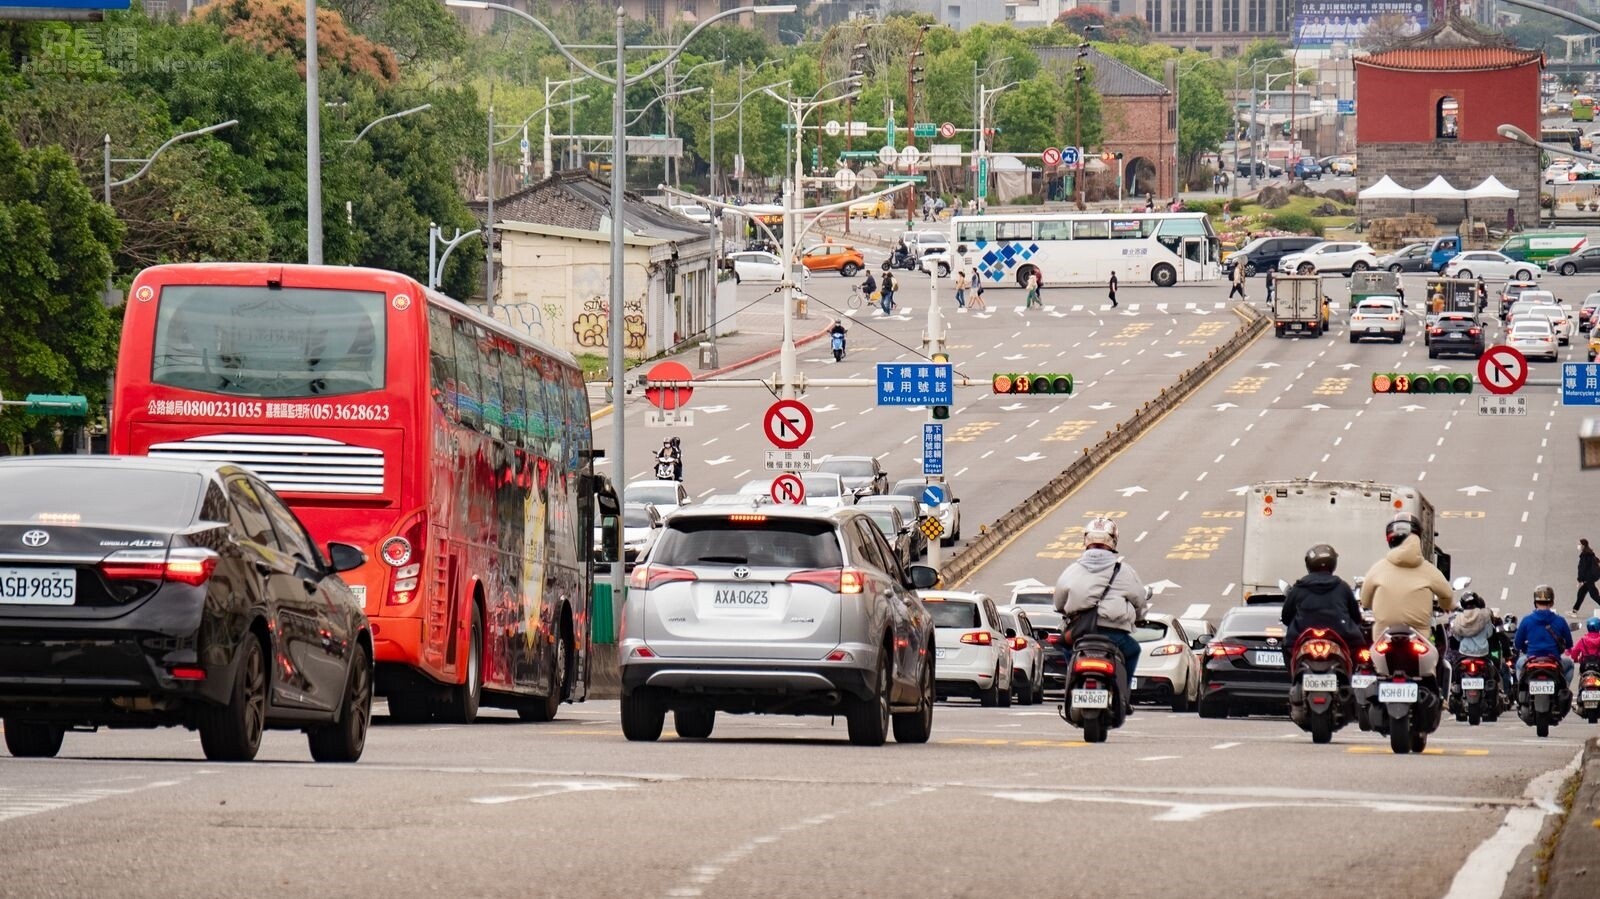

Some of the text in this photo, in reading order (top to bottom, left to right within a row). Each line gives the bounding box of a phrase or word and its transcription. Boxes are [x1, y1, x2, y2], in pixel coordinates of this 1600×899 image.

[883, 381, 947, 393] 專用號誌
[1017, 379, 1029, 391] 53
[1396, 379, 1409, 391] 53
[1565, 378, 1597, 389] 專用
